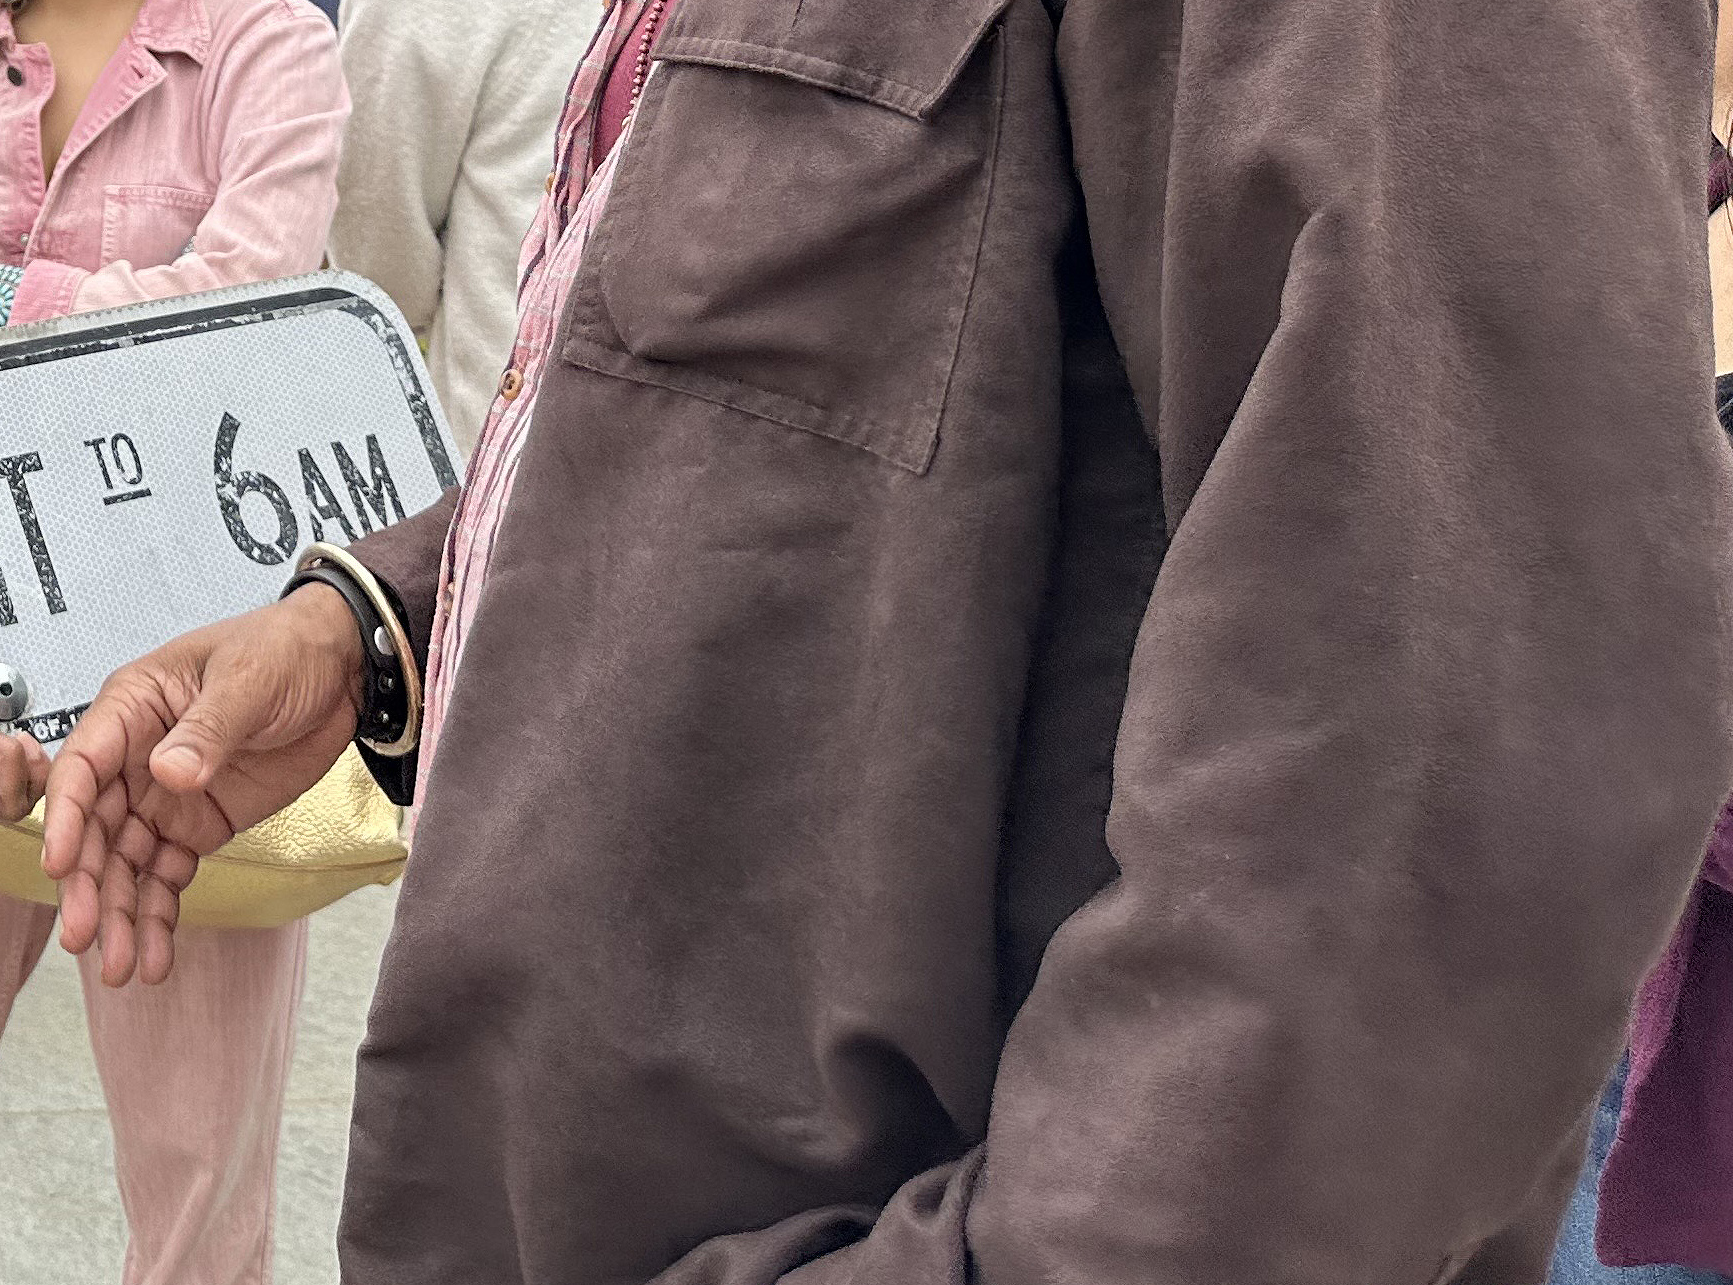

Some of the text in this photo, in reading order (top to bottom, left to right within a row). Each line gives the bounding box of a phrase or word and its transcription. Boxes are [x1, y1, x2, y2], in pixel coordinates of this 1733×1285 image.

[84, 433, 143, 490] TO
[214, 411, 407, 566] 6AM
[33, 717, 60, 741] OF
